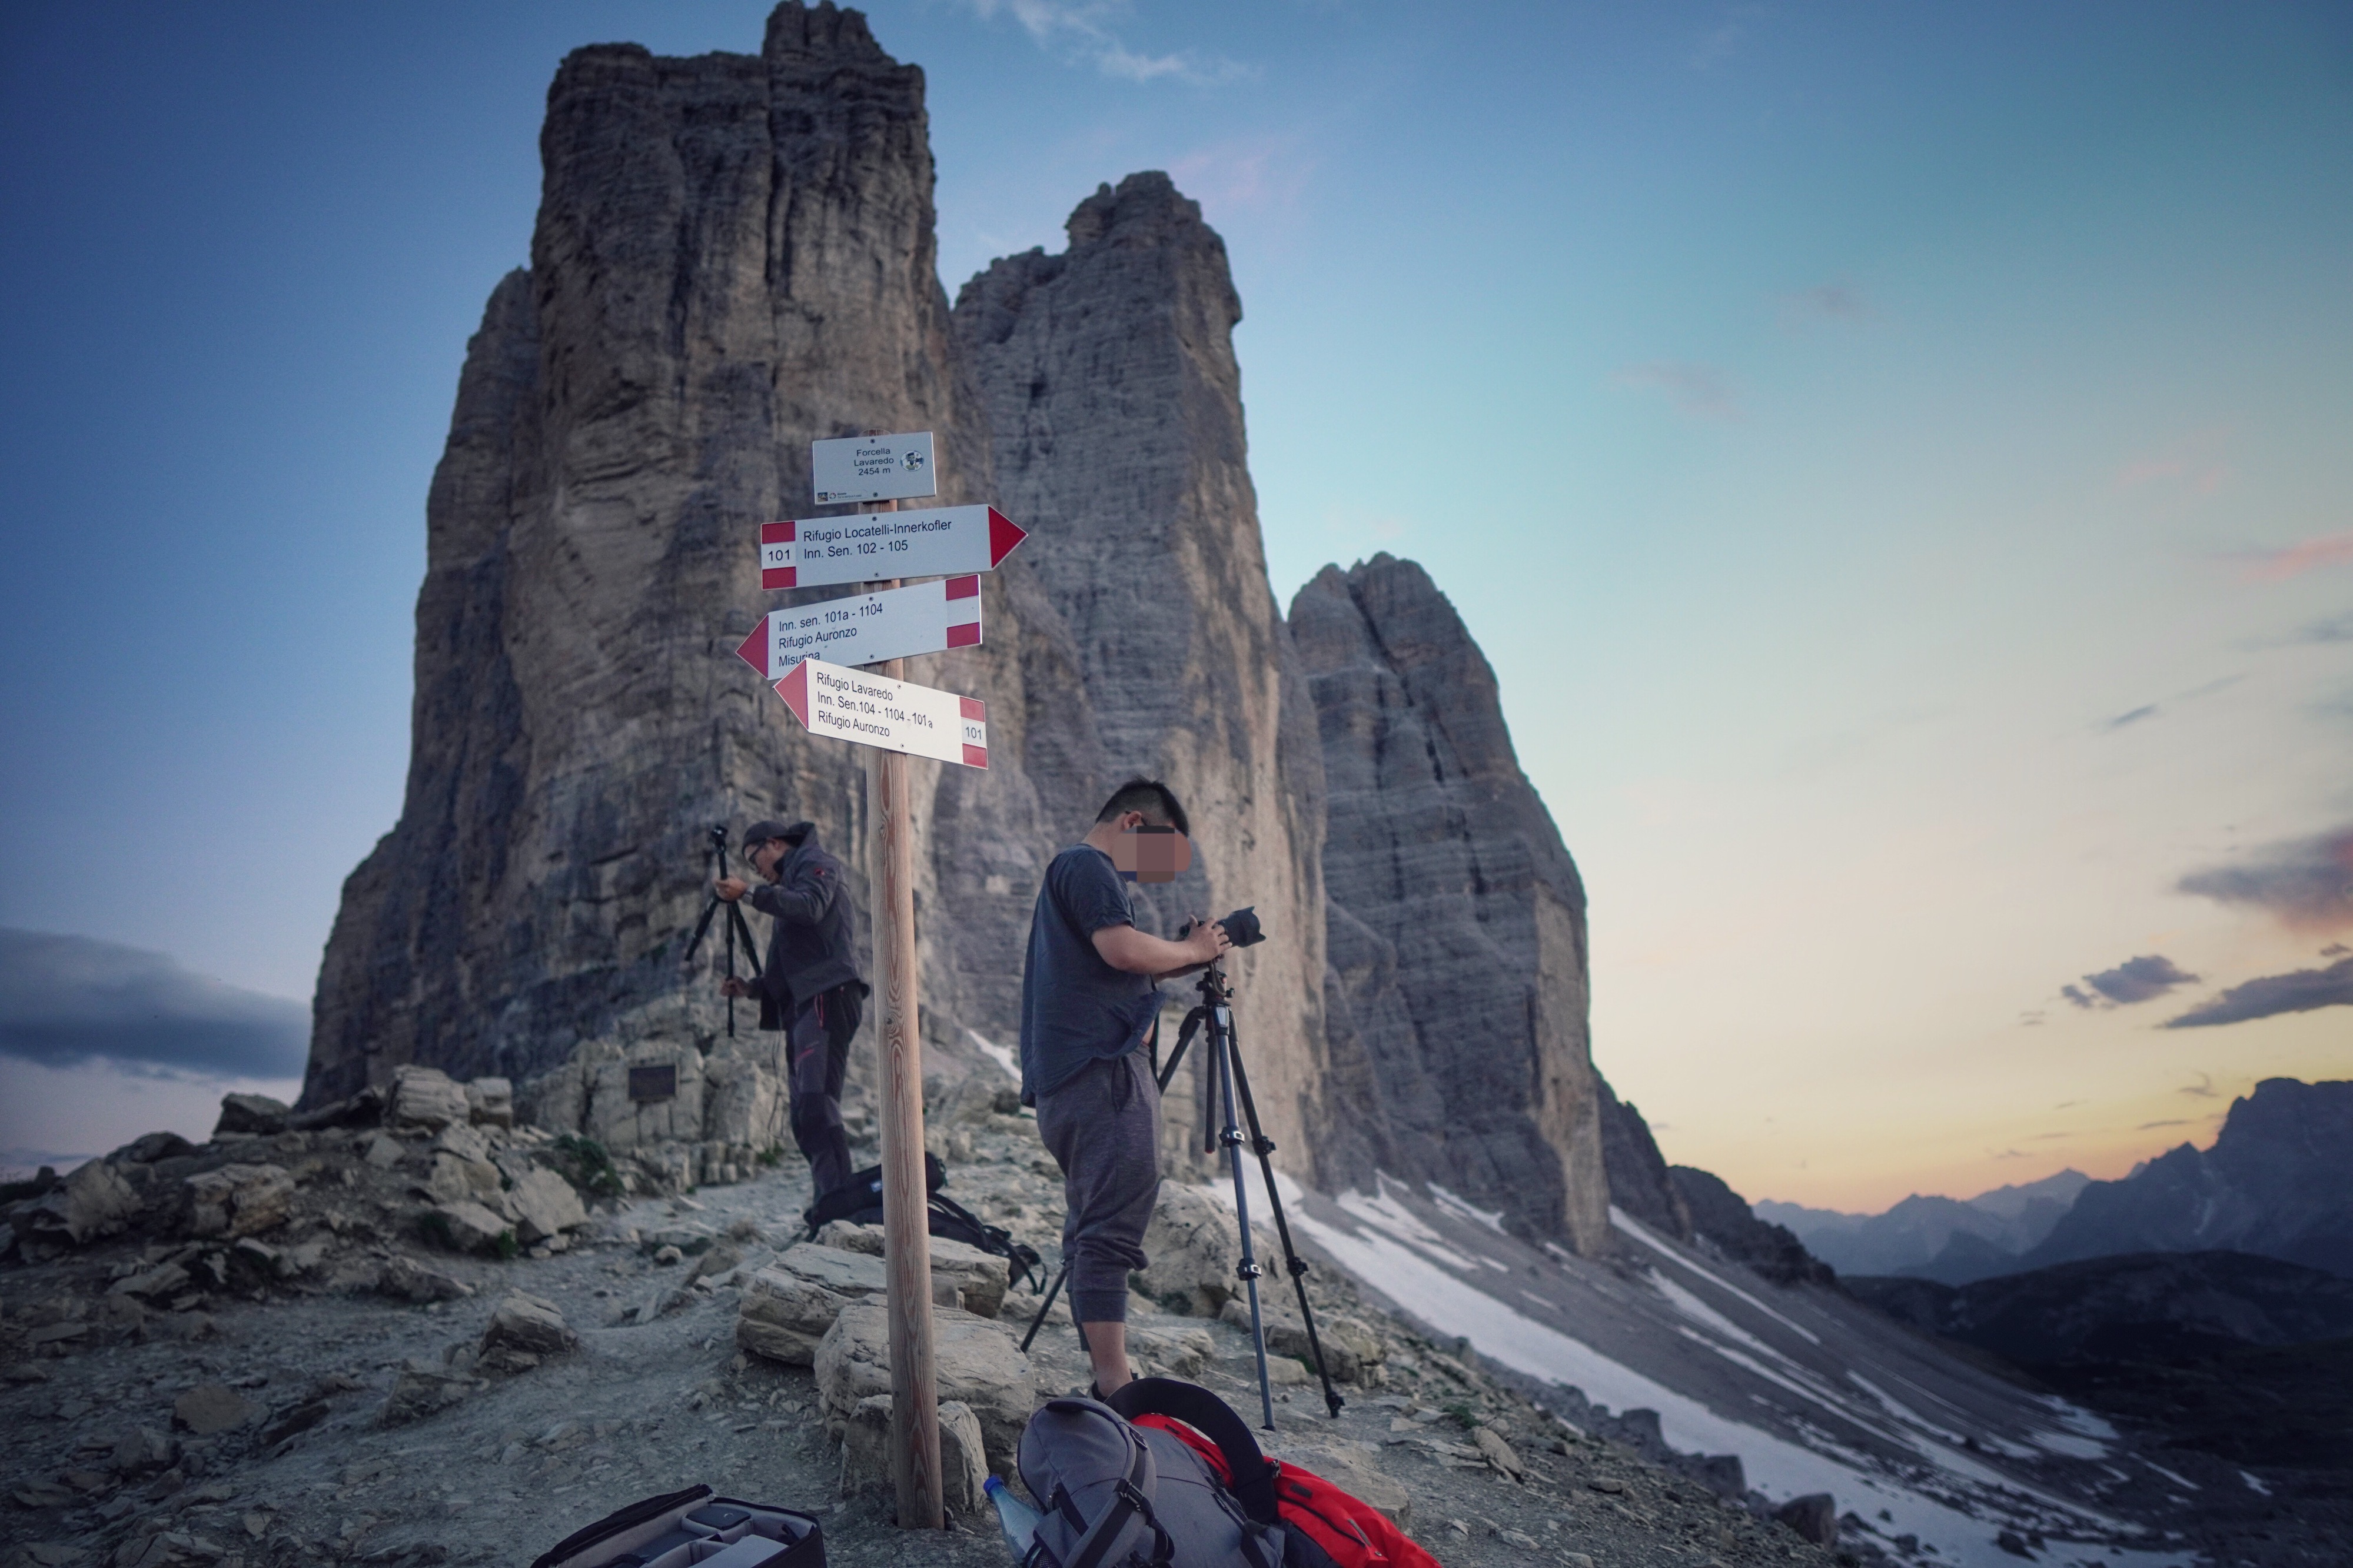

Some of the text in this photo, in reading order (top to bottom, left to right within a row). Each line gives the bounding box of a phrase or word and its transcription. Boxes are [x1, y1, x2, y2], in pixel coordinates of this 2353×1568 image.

[854, 457, 894, 467] Lavaredo
[856, 448, 890, 457] Forcella
[804, 520, 952, 542] Rifugio Locatelli-Innerkofler
[768, 549, 790, 561] 101
[804, 548, 823, 559] Inn.
[827, 546, 852, 557] Sen.
[857, 542, 876, 554] 102
[888, 540, 908, 551] 105
[779, 621, 796, 632] Inn.
[800, 617, 820, 628] sen.
[825, 610, 849, 623] 101a
[859, 603, 883, 617] 1104
[779, 628, 857, 649] Rifugio Auronzo
[817, 672, 893, 701] Rifugio Lavaredo
[818, 691, 835, 706] Inn.
[885, 707, 905, 722] 1104
[819, 710, 890, 737] Rifugio Auronzo
[965, 726, 982, 740] 101
